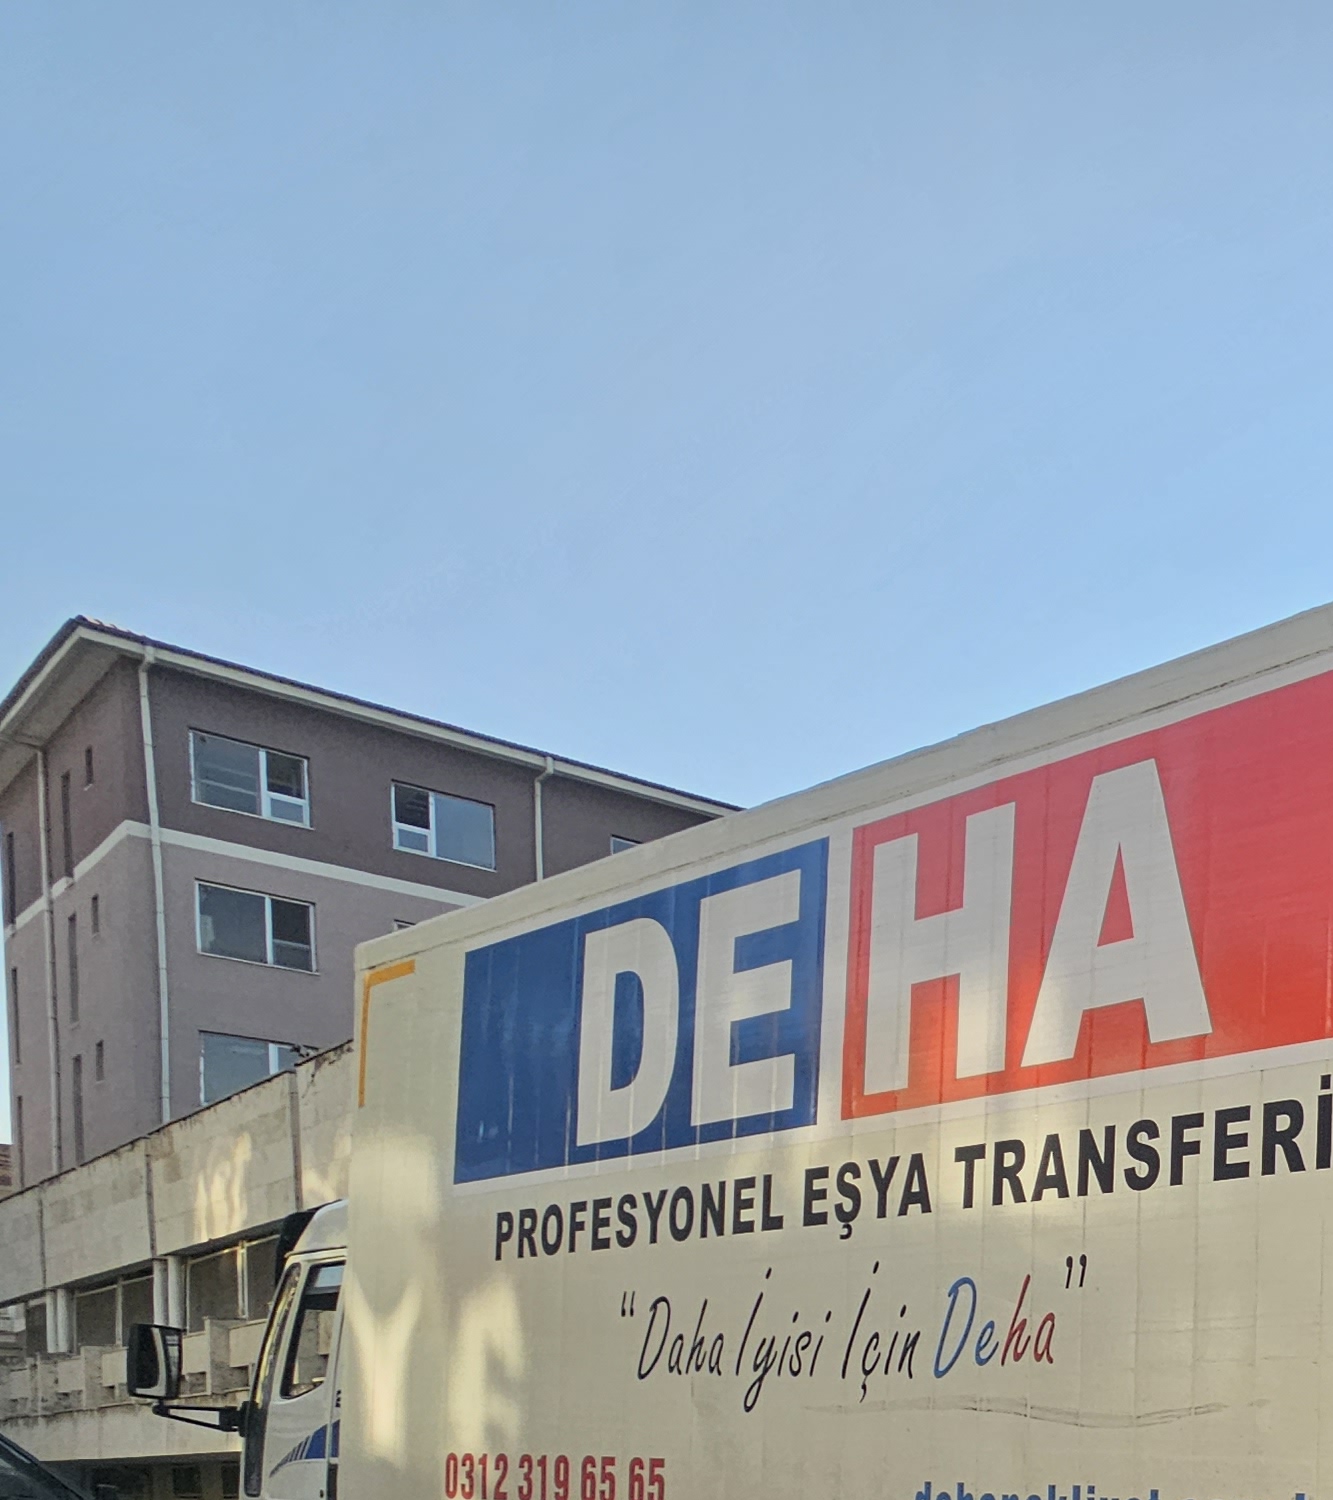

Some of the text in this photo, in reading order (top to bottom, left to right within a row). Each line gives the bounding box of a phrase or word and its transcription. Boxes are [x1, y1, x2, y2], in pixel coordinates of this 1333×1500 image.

[575, 757, 1213, 1148] DEHA
[494, 1074, 1333, 1261] PROFESYONEL EŞYA TRANSFERİ
[841, 1260, 921, 1403] İçin
[445, 1452, 508, 1500] 0312
